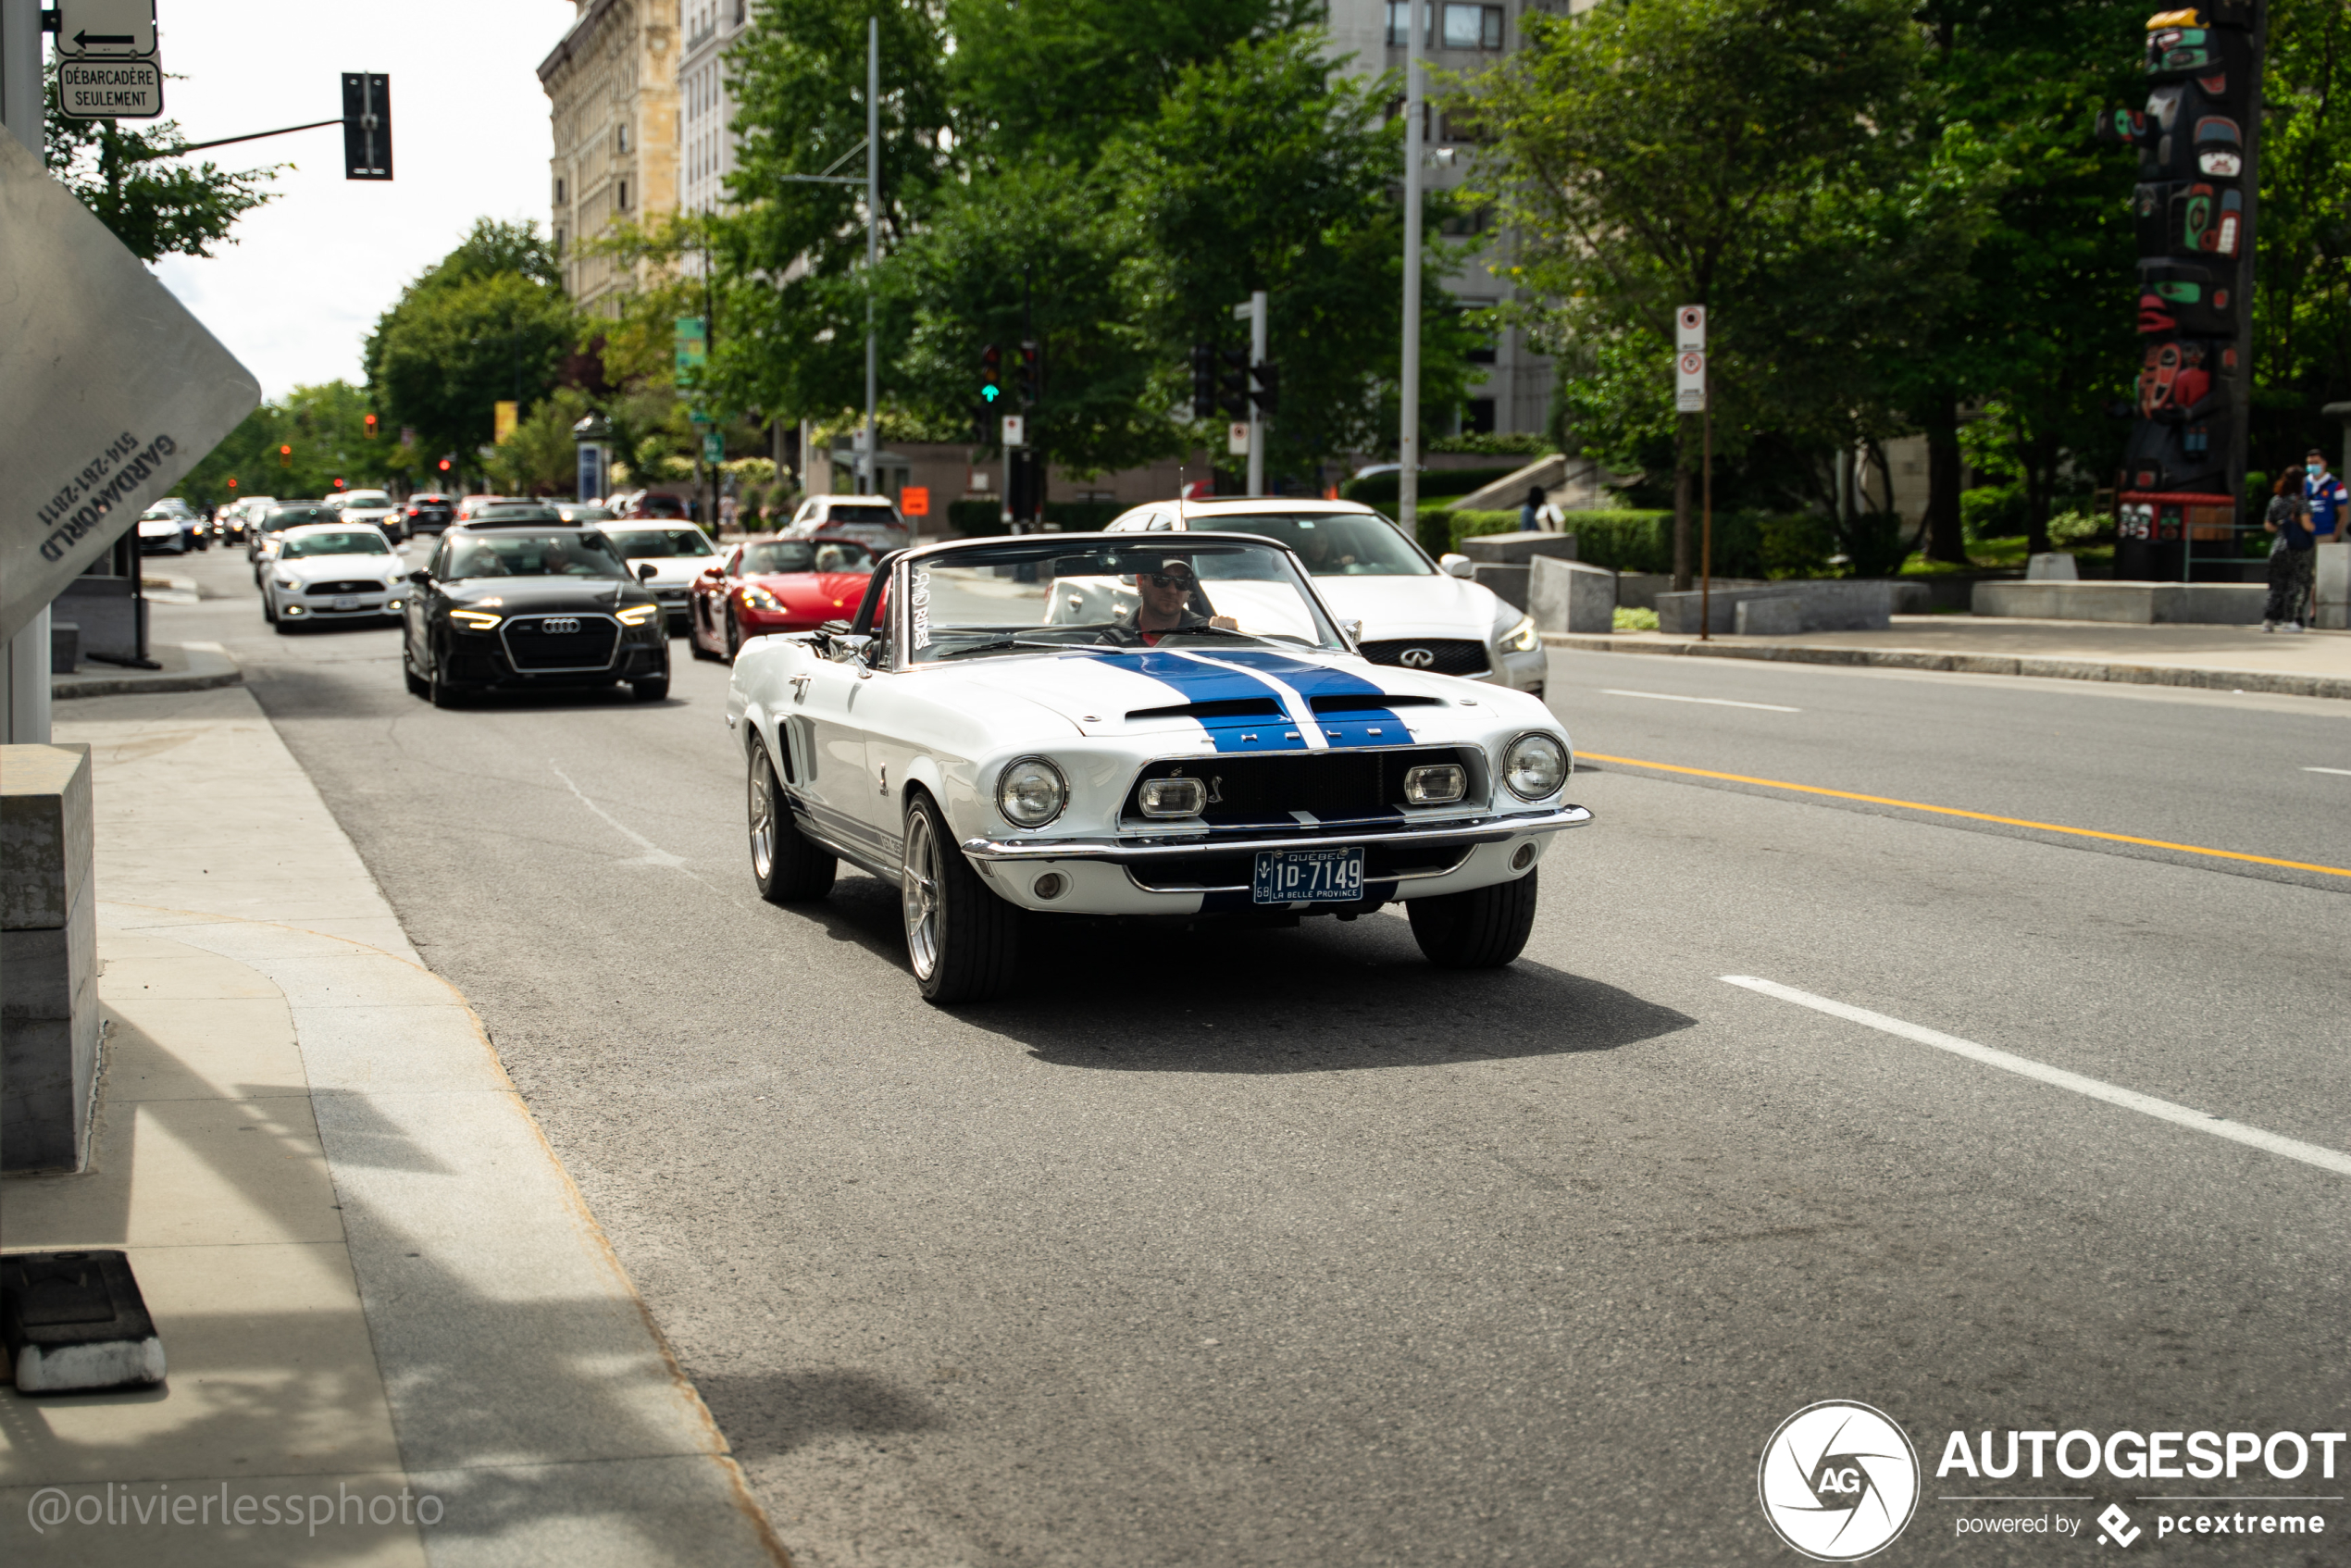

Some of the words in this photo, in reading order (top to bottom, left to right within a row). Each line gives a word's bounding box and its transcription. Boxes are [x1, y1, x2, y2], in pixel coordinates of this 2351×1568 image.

[65, 67, 154, 85] DÉBARCADÈRE
[75, 91, 146, 106] SEULEMENT
[36, 431, 139, 526] 514-281-2811
[39, 434, 177, 562] GARDAWORLD
[914, 606, 932, 650] RIDES
[1276, 859, 1361, 891] 1D-7149
[1256, 886, 1270, 898] 68
[1287, 890, 1313, 899] BELLE
[1316, 889, 1358, 898] PROVINCE
